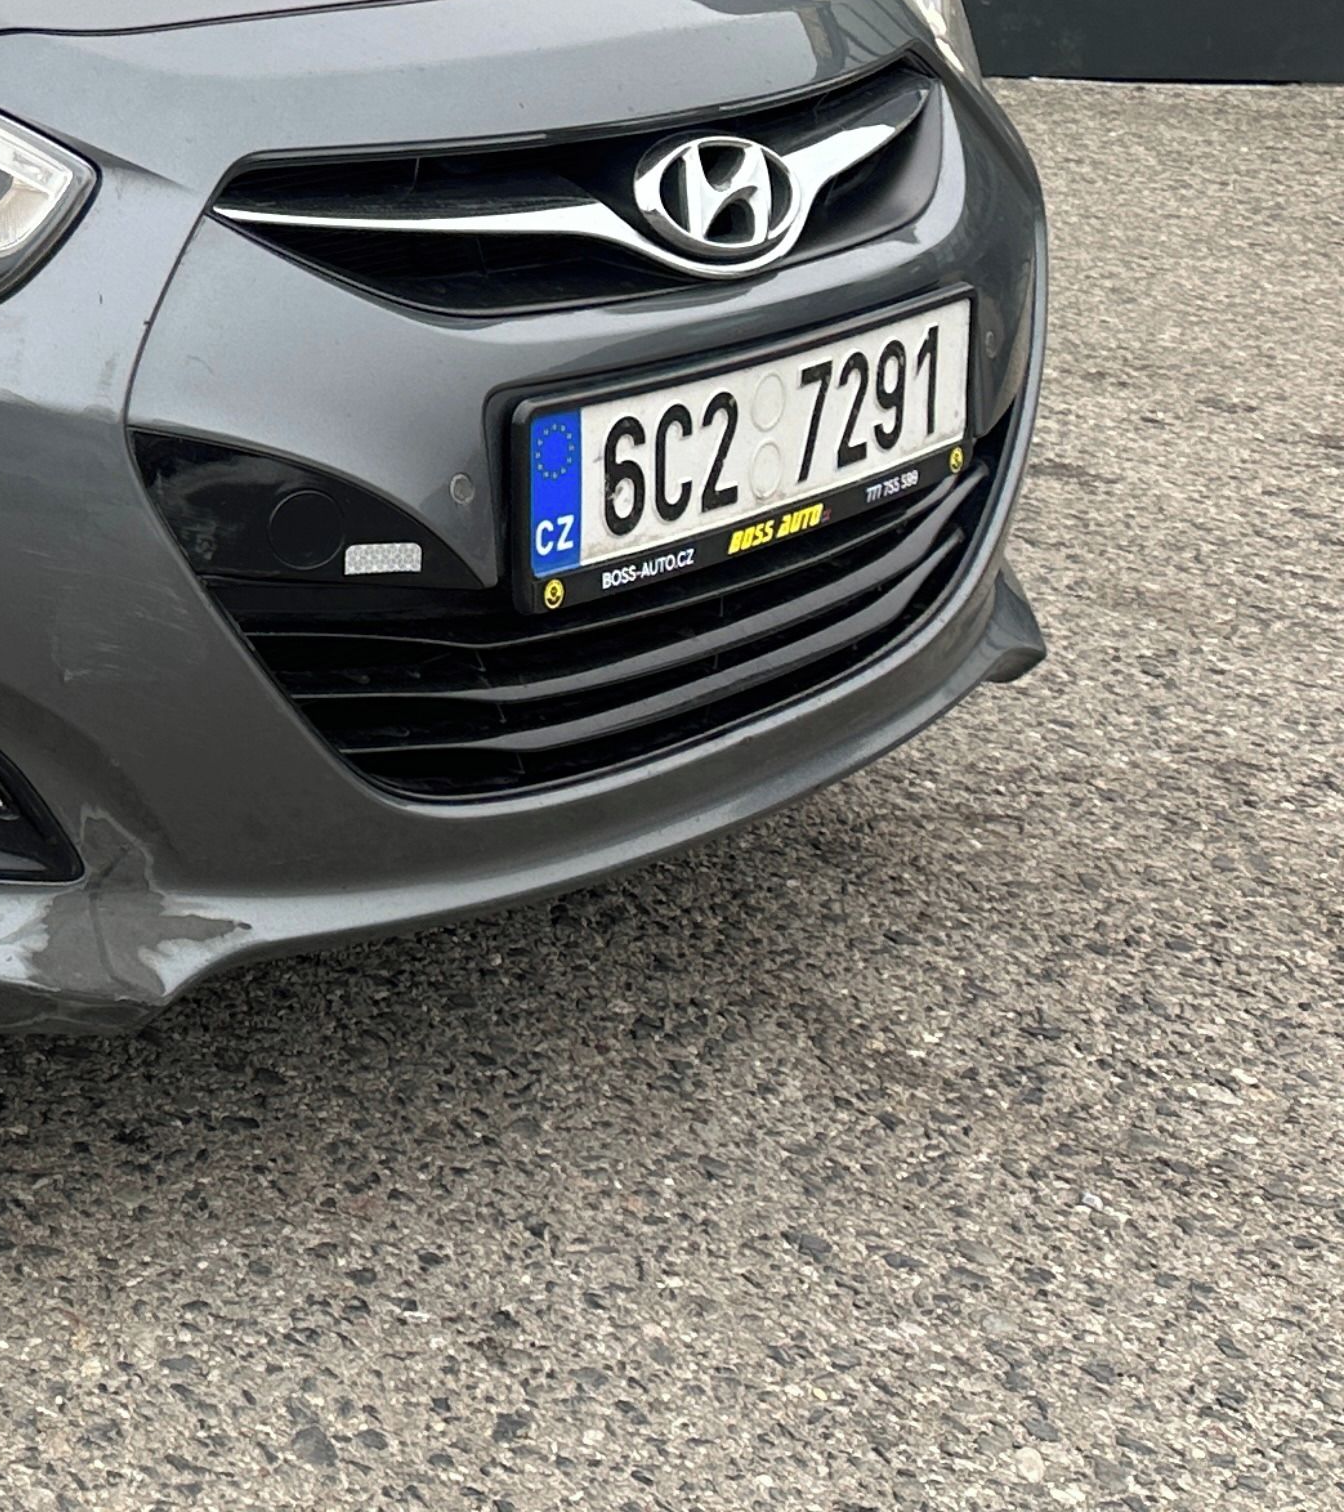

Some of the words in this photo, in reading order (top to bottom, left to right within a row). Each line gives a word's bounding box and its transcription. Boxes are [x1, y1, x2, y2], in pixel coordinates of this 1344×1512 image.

[602, 391, 739, 536] 6C2
[797, 324, 940, 483] 7291
[535, 514, 574, 557] CZ
[728, 519, 775, 555] BOSS
[775, 503, 824, 538] AUTO
[602, 548, 695, 589] BOSS-AUTO.CZ
